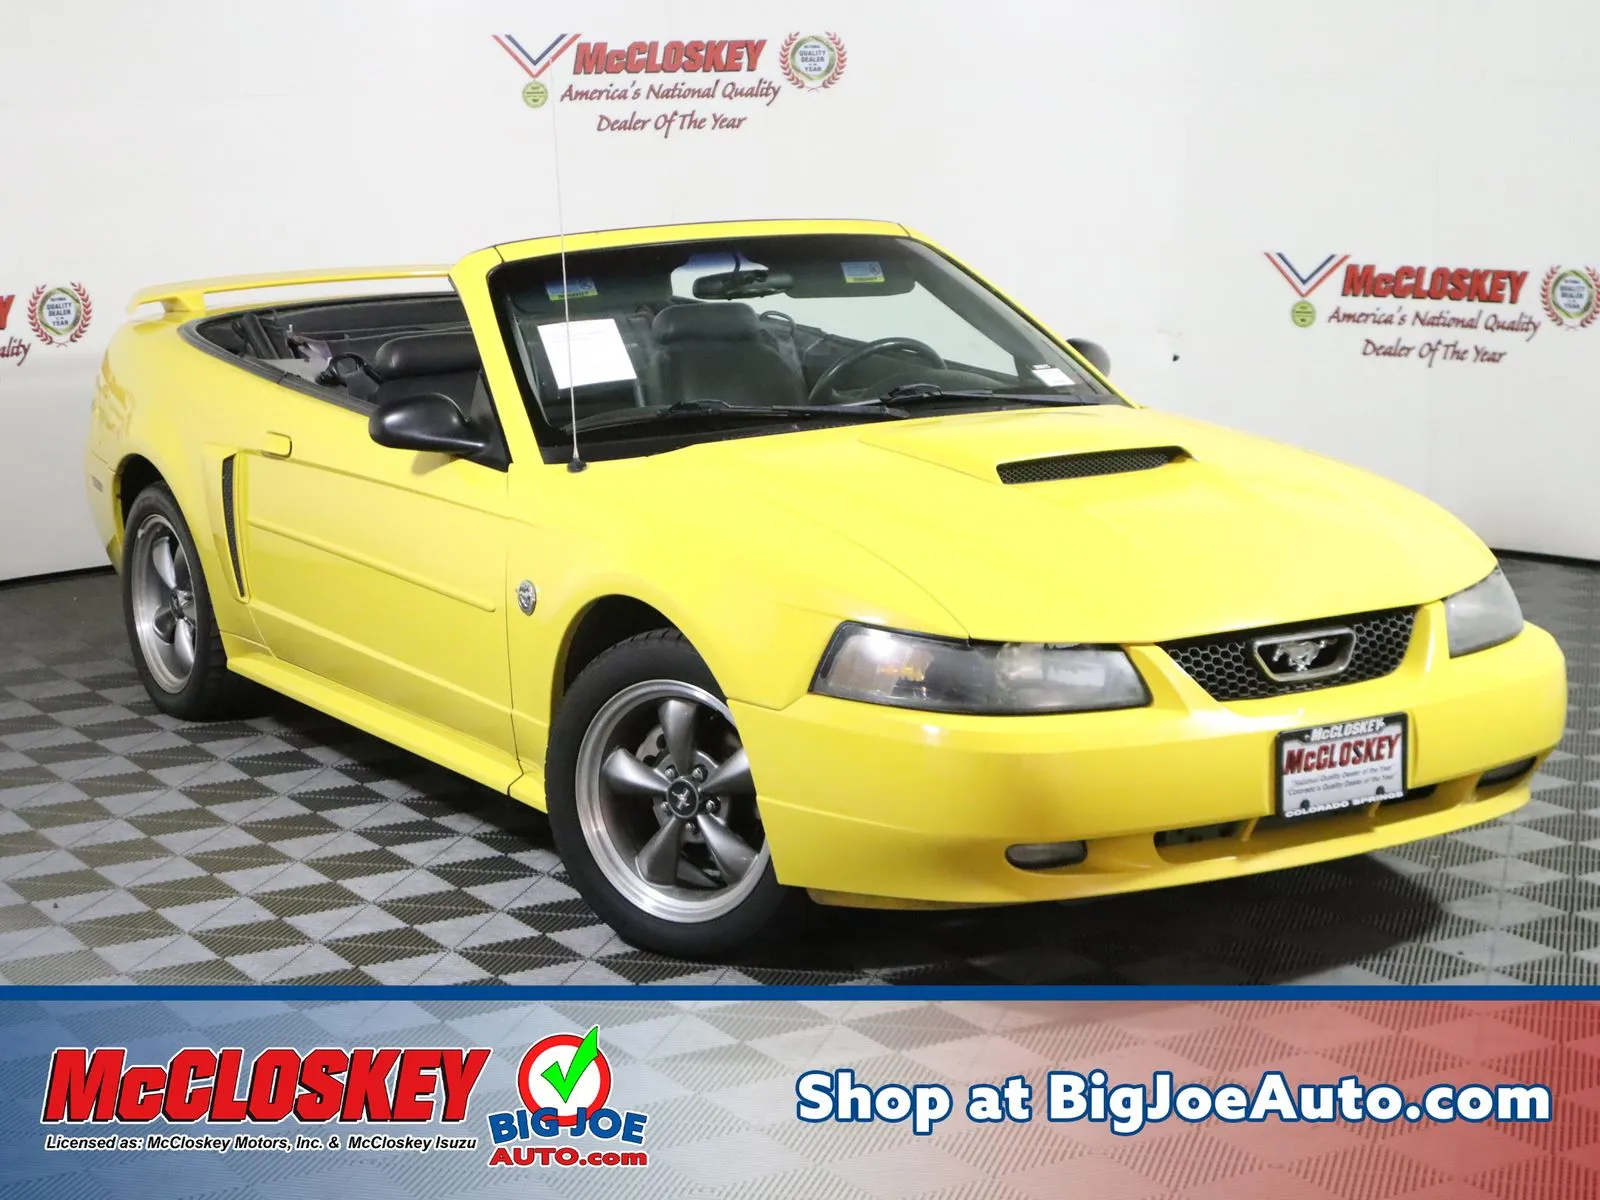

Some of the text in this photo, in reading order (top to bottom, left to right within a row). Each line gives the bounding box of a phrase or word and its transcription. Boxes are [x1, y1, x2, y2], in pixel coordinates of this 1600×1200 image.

[573, 39, 767, 75] McCLOSKEY
[560, 81, 640, 102] America's
[646, 78, 718, 101] National
[722, 79, 781, 106] Quality
[597, 111, 748, 138] Dealer Of The Year
[1342, 264, 1529, 304] McCLOSKEY
[46, 302, 72, 310] QUALITY
[48, 309, 71, 317] DEALER
[1328, 306, 1407, 327] America's
[1411, 309, 1481, 330] National
[1483, 311, 1542, 342] Quality
[0, 337, 31, 366] ality
[1362, 337, 1507, 367] Dealer Of The Year
[1311, 717, 1384, 741] McCLOSKEY
[1283, 733, 1401, 775] McCLOSKEY
[1285, 791, 1404, 818] COLORADO SPRINGS
